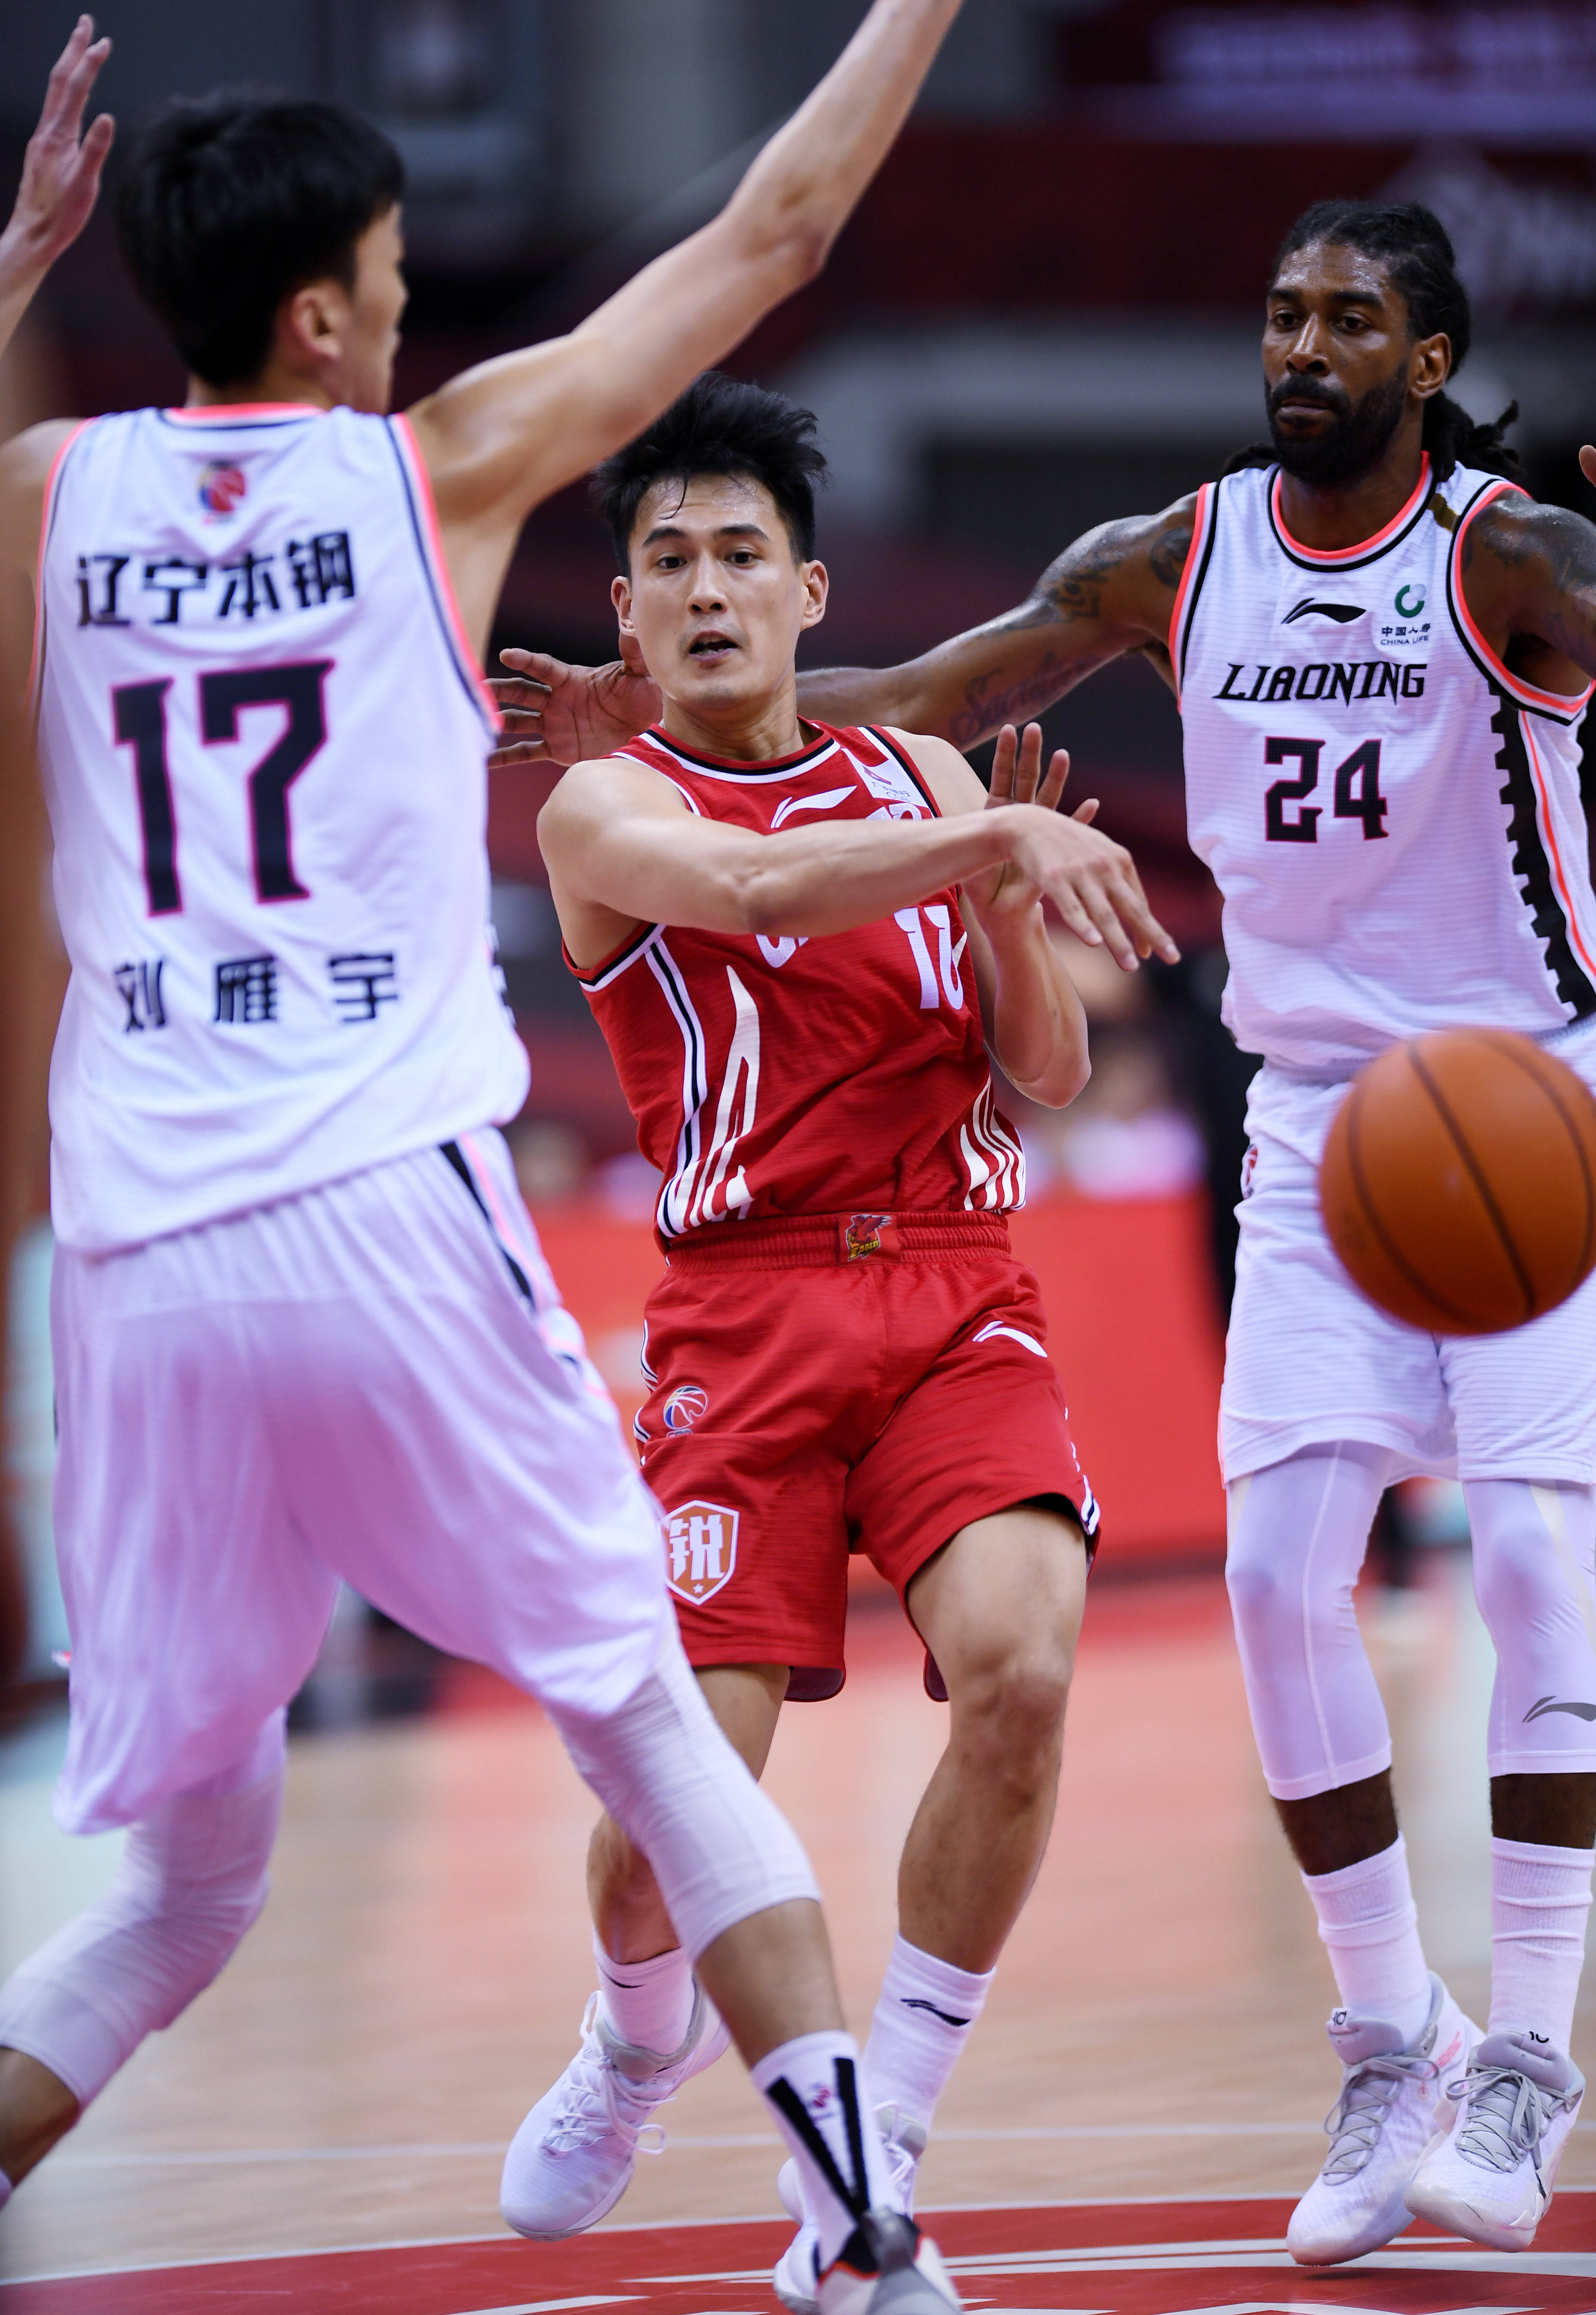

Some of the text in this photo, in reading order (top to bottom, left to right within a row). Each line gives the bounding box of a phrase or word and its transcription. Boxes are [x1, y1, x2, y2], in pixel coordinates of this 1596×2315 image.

[77, 531, 356, 628] 辽宁本钢
[1412, 634, 1429, 644] LIFE
[1212, 661, 1427, 707] LIAONING
[109, 658, 337, 919] 17
[1264, 736, 1389, 844] 24
[114, 952, 398, 1033] 刘雁宇
[669, 1514, 725, 1582] 锐
